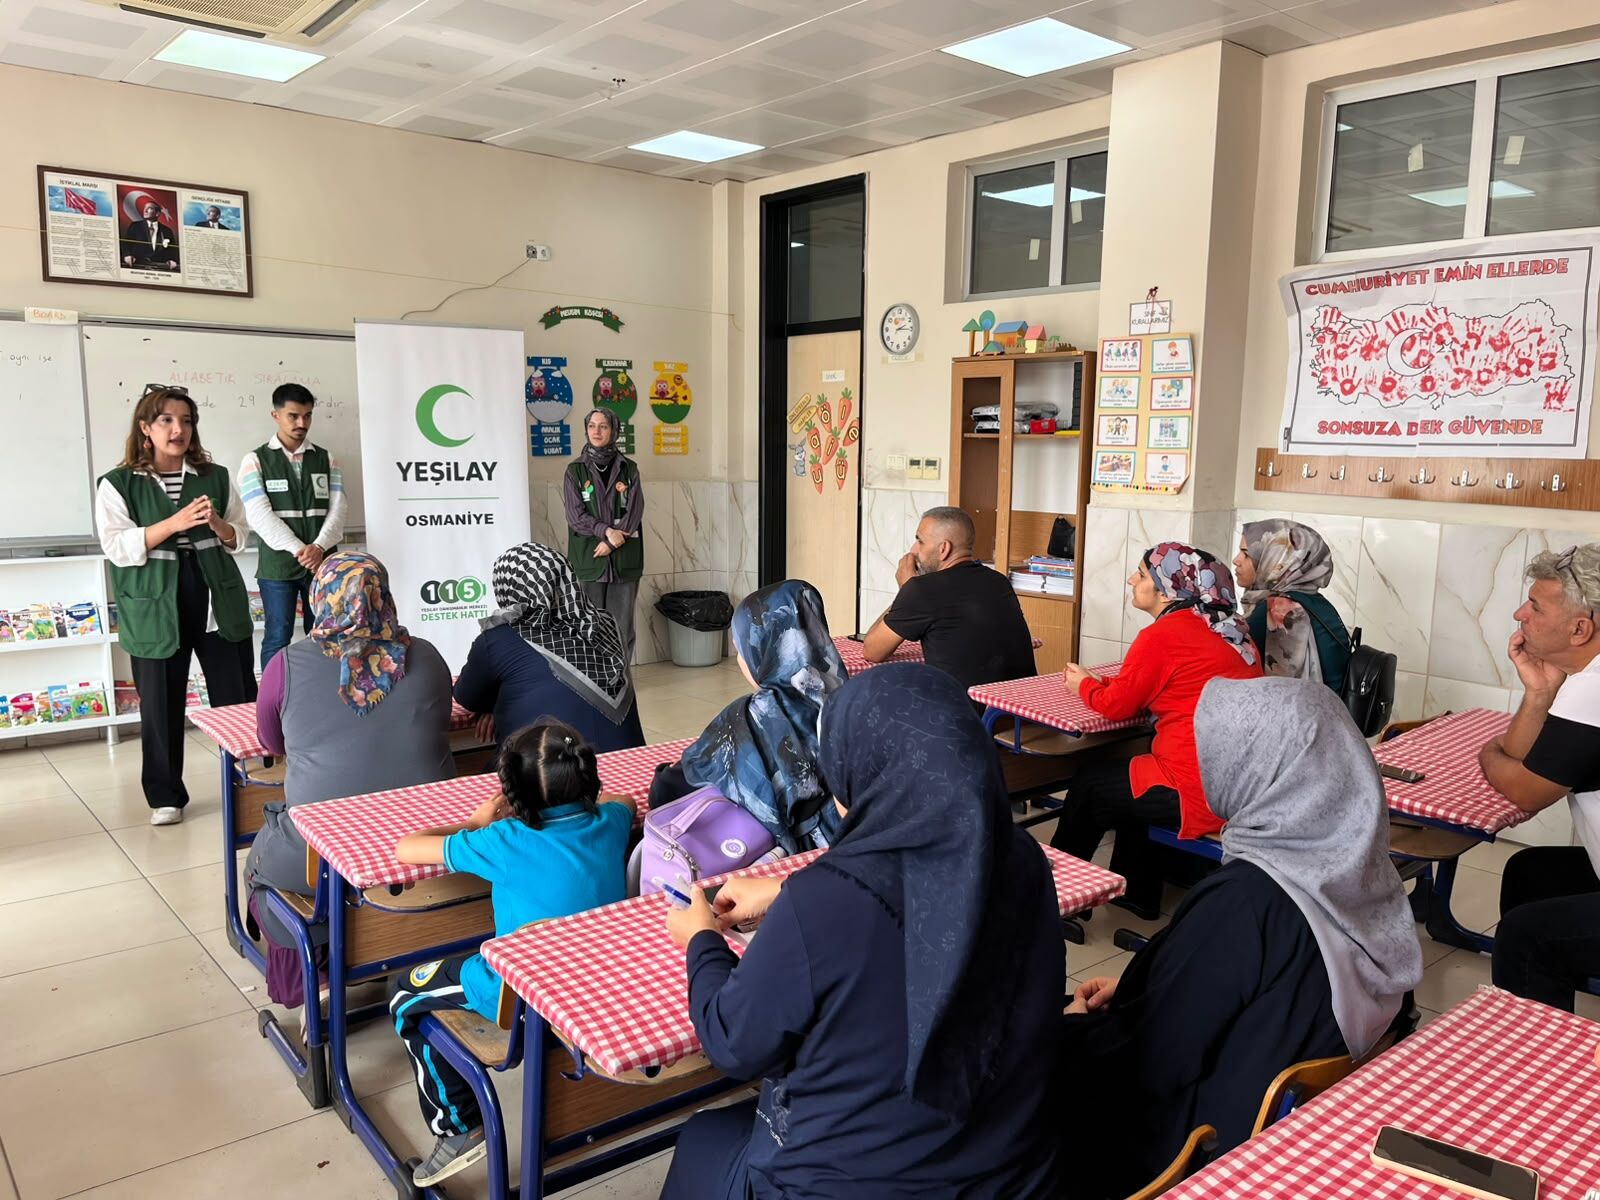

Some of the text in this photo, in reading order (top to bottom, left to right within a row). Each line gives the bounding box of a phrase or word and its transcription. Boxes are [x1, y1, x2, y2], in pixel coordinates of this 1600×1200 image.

[1305, 258, 1570, 296] CUMHURİYET EMİN ELLERDE
[1317, 416, 1544, 436] SONSUZA DEK GÜVENDE
[405, 511, 495, 527] OSMANİYE
[421, 609, 488, 622] DESTEK HATTI
